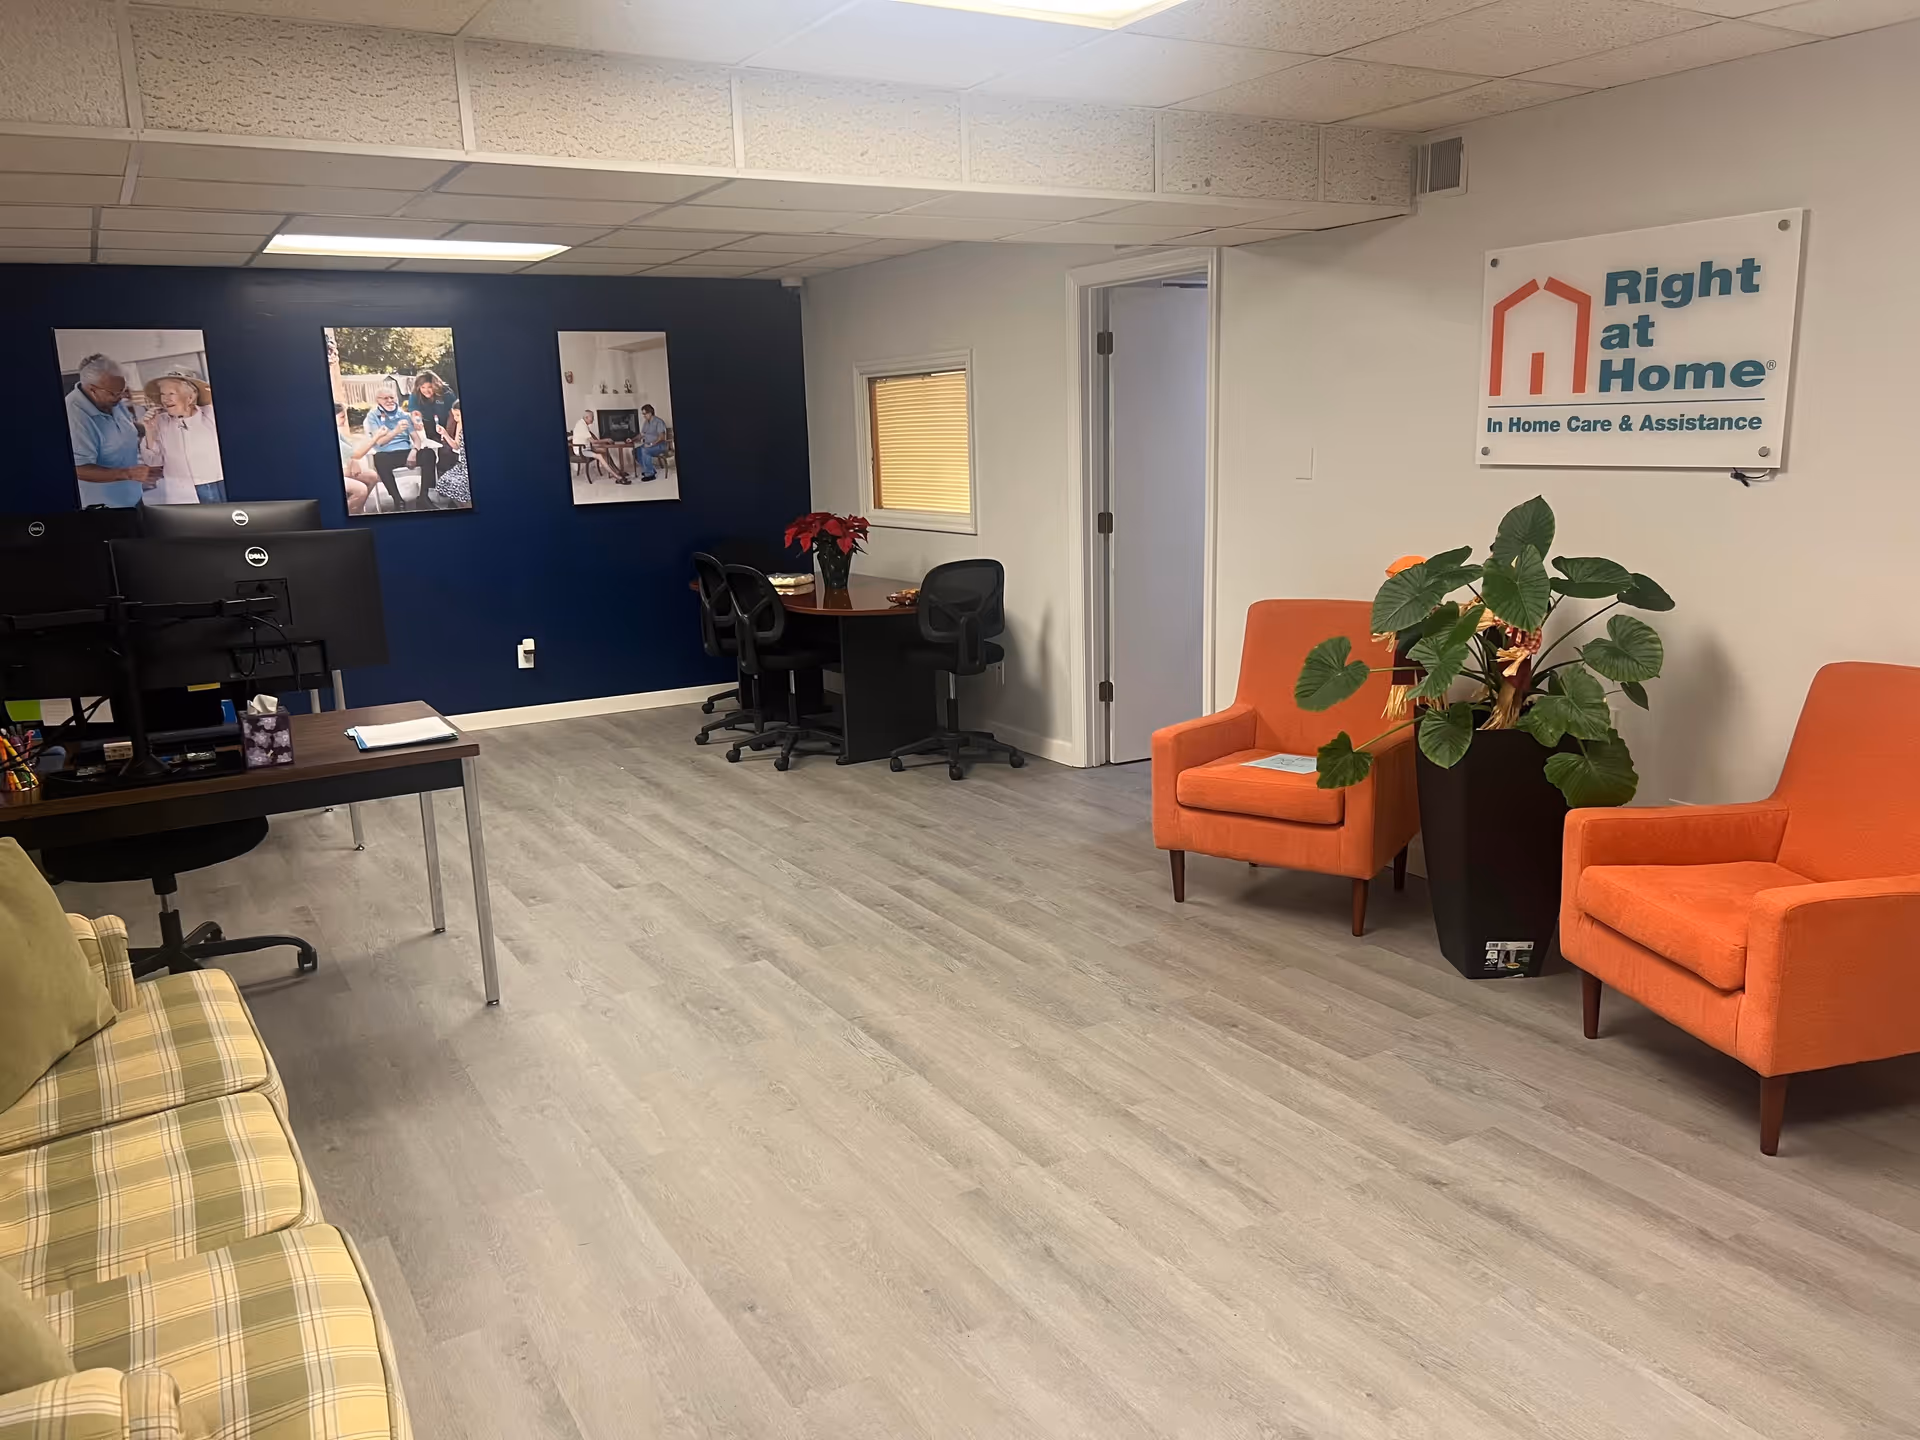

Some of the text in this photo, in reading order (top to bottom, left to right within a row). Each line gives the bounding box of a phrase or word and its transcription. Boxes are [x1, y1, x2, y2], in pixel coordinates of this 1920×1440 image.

[1604, 257, 1762, 309] Right
[1600, 314, 1656, 351] at
[1486, 413, 1763, 433] In Home Care & Assistance
